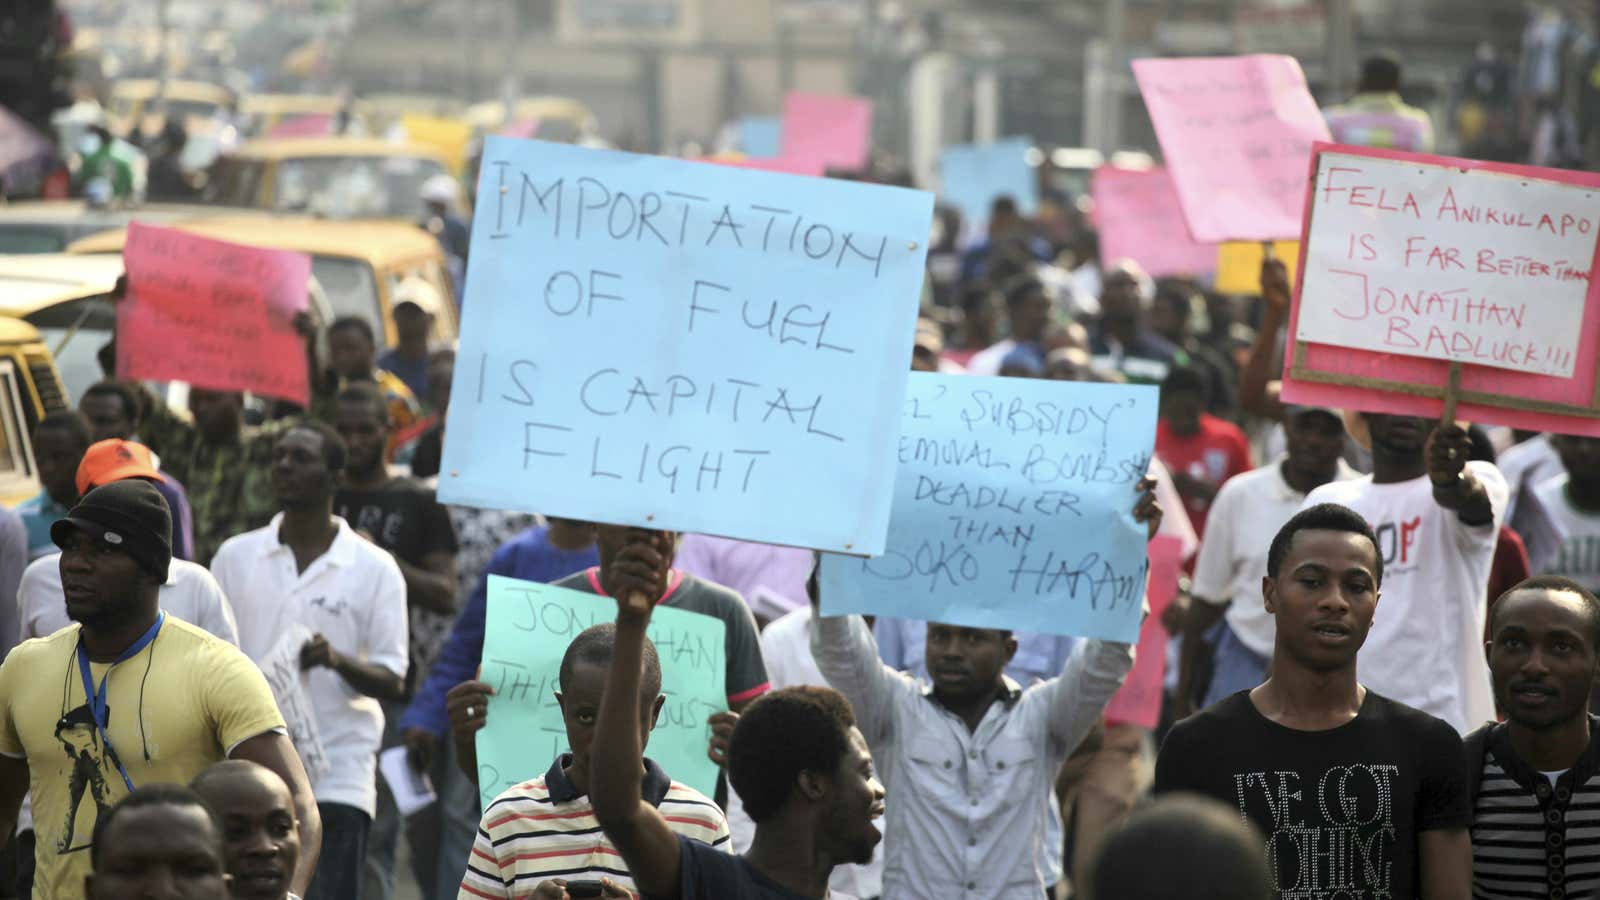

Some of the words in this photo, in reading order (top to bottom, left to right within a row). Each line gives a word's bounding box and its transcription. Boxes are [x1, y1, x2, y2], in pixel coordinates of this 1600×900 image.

[490, 161, 887, 278] IMPORTATION
[1323, 168, 1420, 220] FELA
[1437, 187, 1591, 236] ANIKULAPO
[1348, 234, 1376, 260] IS
[1405, 237, 1465, 270] FAR
[1477, 250, 1549, 276] BETTER
[544, 270, 624, 316] OF
[688, 280, 854, 353] FUEL
[1328, 269, 1525, 328] JONATHAN
[478, 353, 537, 407] IS
[580, 369, 845, 441] CAPITAL
[522, 422, 770, 493] FLIGHT
[899, 436, 1011, 469] EMOVAL
[914, 475, 1082, 517] DEADLIER
[950, 516, 1035, 550] THAN
[1318, 763, 1399, 831] GOT
[1263, 826, 1395, 892] OTHING
